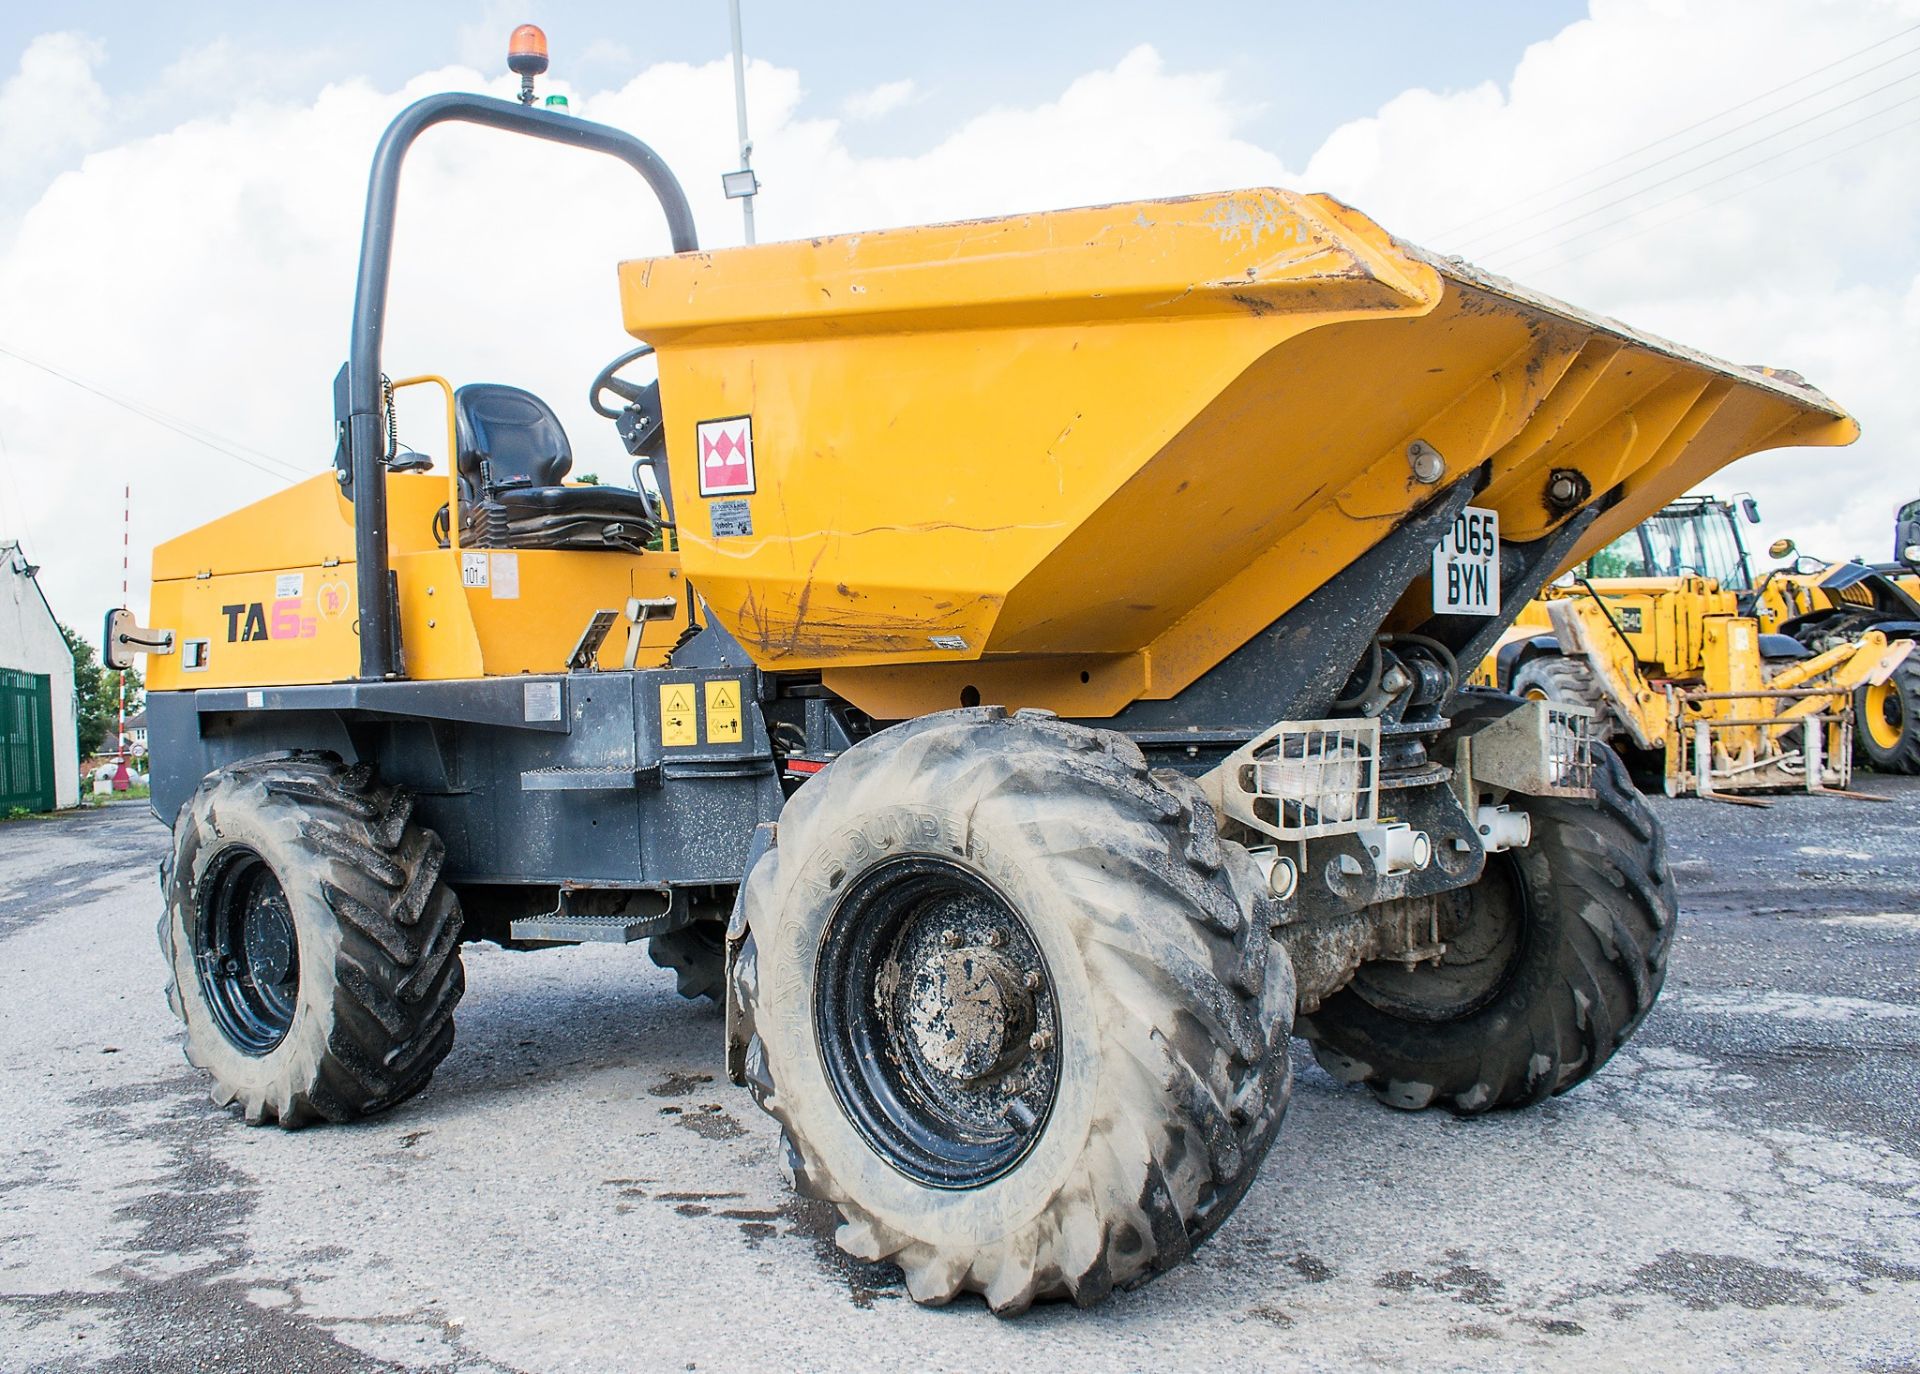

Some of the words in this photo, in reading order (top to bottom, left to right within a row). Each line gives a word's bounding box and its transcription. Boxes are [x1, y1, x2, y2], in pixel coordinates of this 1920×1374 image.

[465, 567, 478, 584] 101
[1448, 563, 1488, 606] BYN
[840, 812, 991, 870] DUMPER
